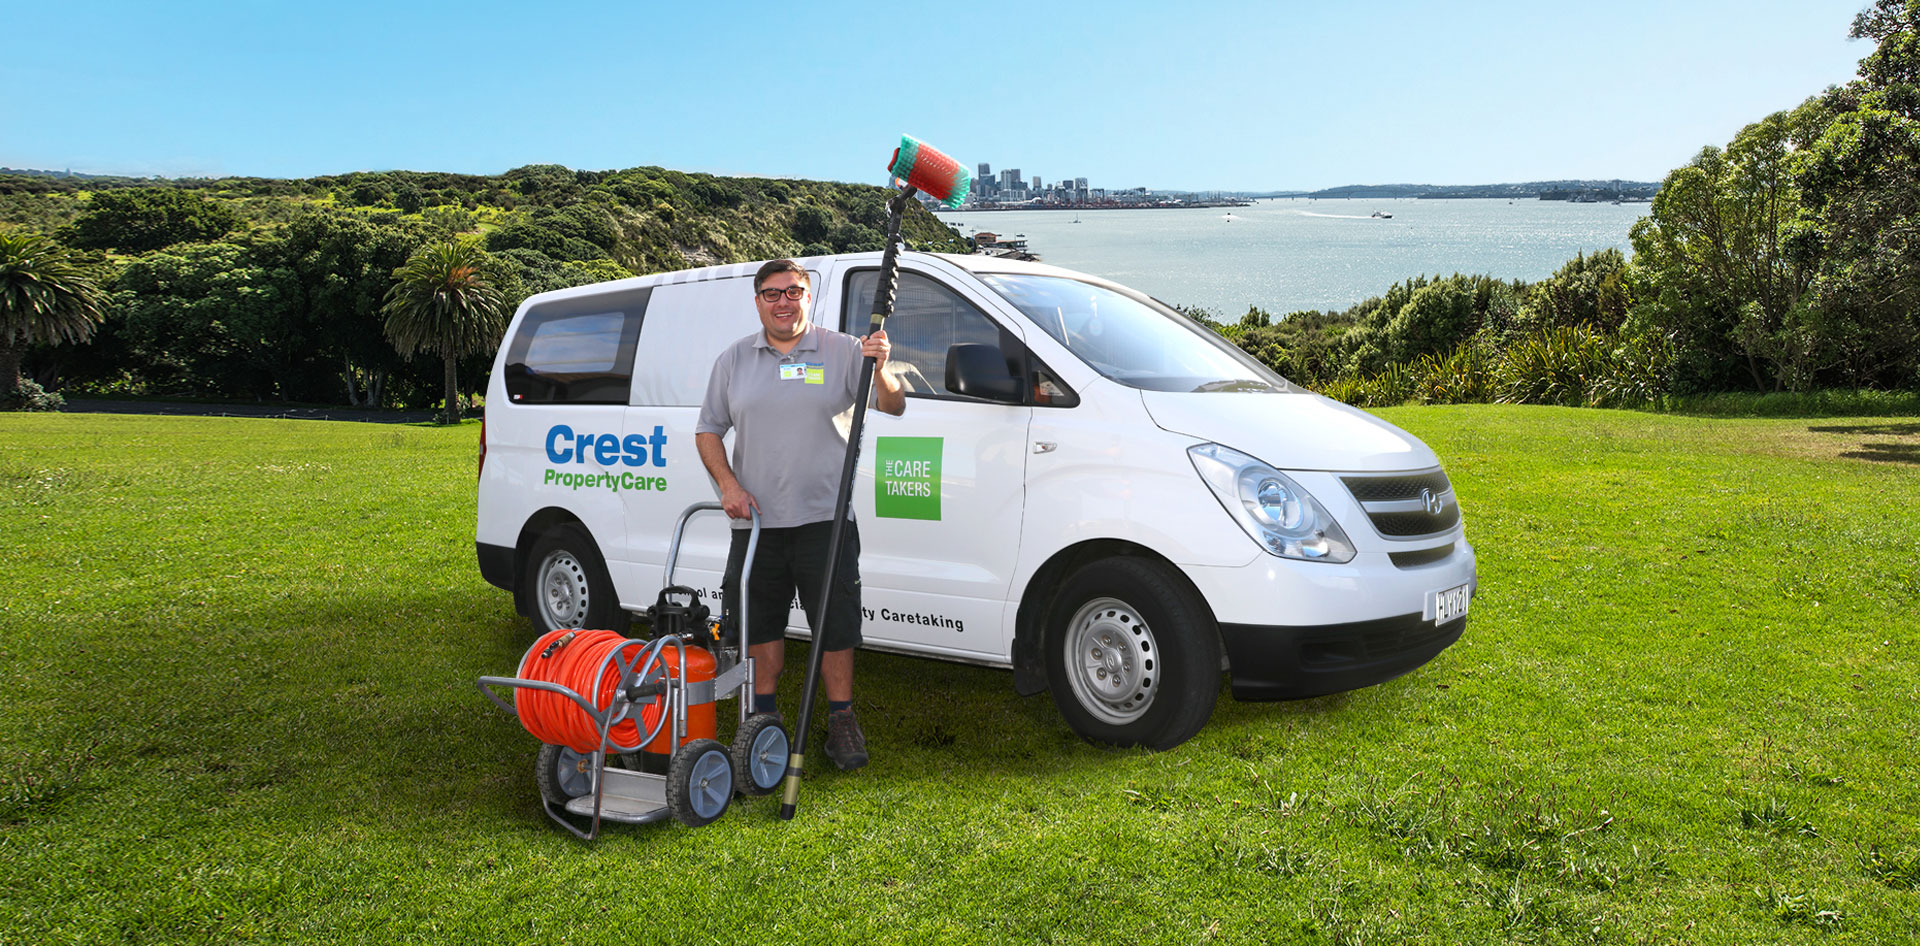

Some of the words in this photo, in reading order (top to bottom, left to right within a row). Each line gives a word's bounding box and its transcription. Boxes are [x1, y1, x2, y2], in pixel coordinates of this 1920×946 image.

[545, 424, 667, 467] Crest
[885, 459, 894, 478] THE
[894, 460, 931, 478] CARE
[544, 469, 667, 493] PropertyCare
[885, 481, 931, 497] TAKERS
[881, 608, 964, 633] Caretaking
